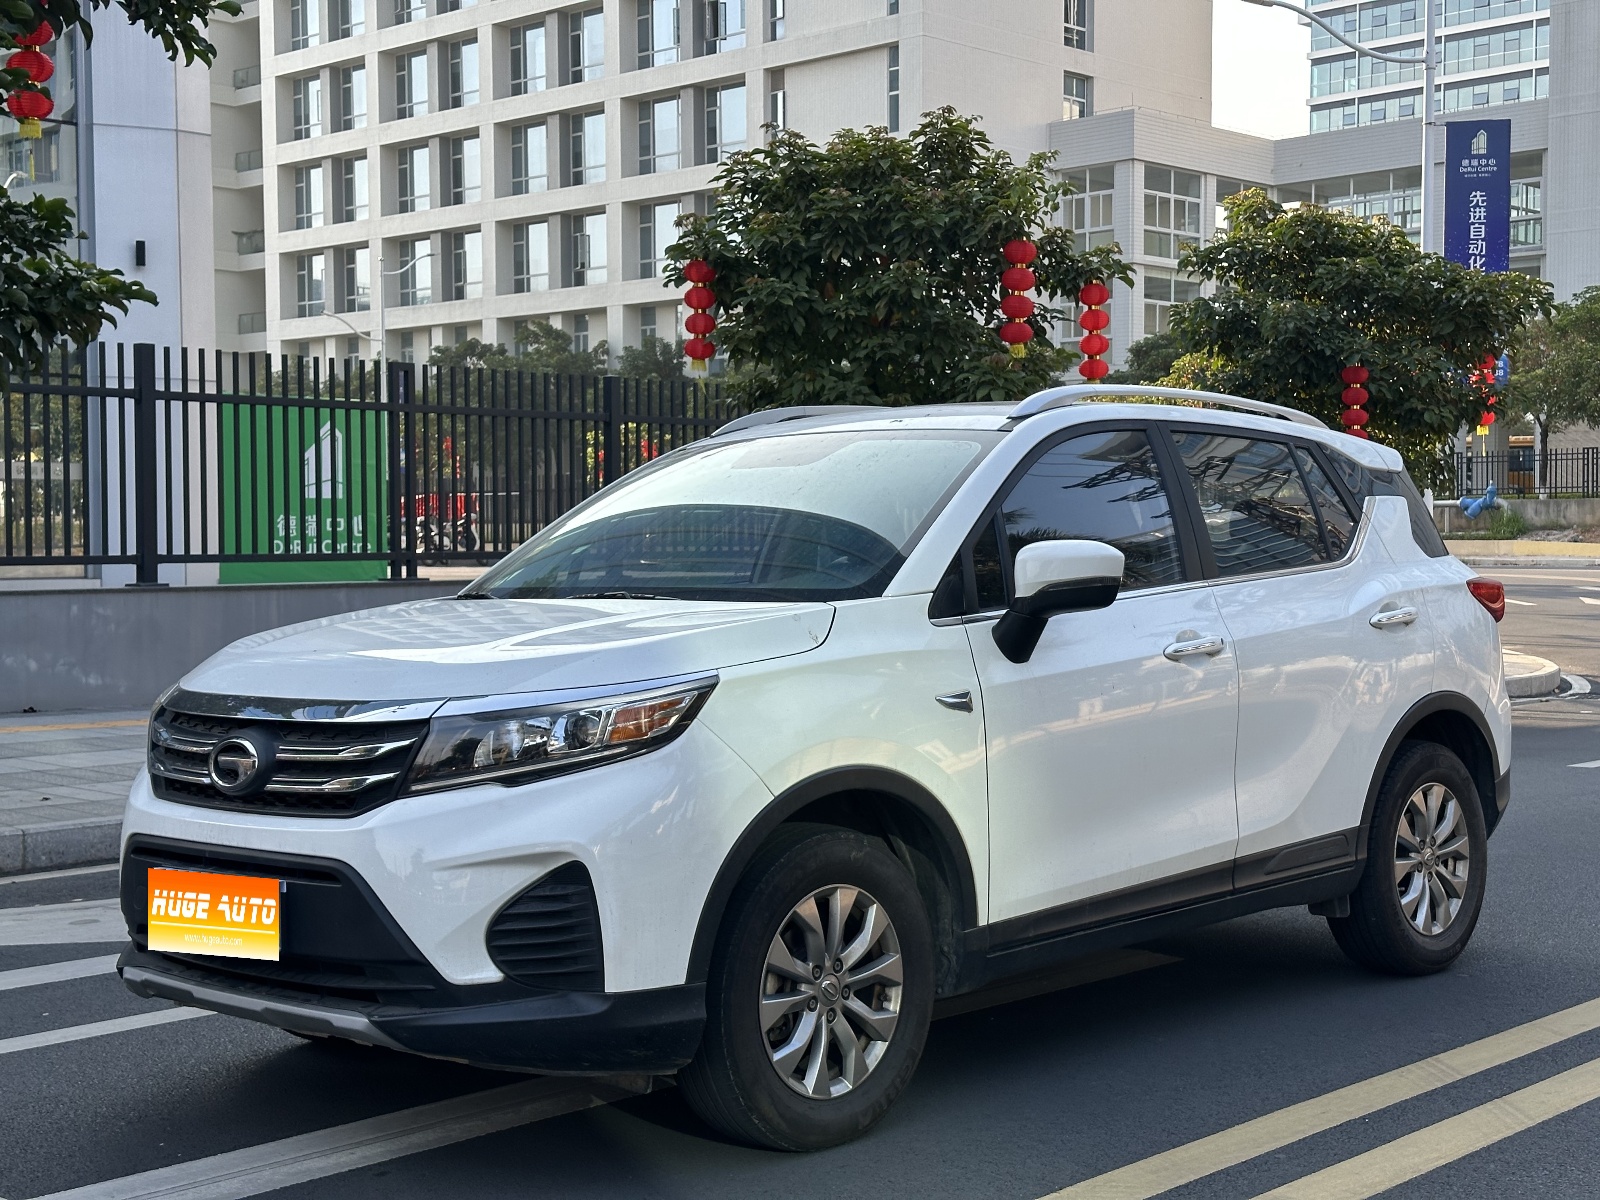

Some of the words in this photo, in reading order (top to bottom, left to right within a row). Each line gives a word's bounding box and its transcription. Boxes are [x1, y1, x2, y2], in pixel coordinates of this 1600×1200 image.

[1468, 190, 1487, 276] 先进自动化
